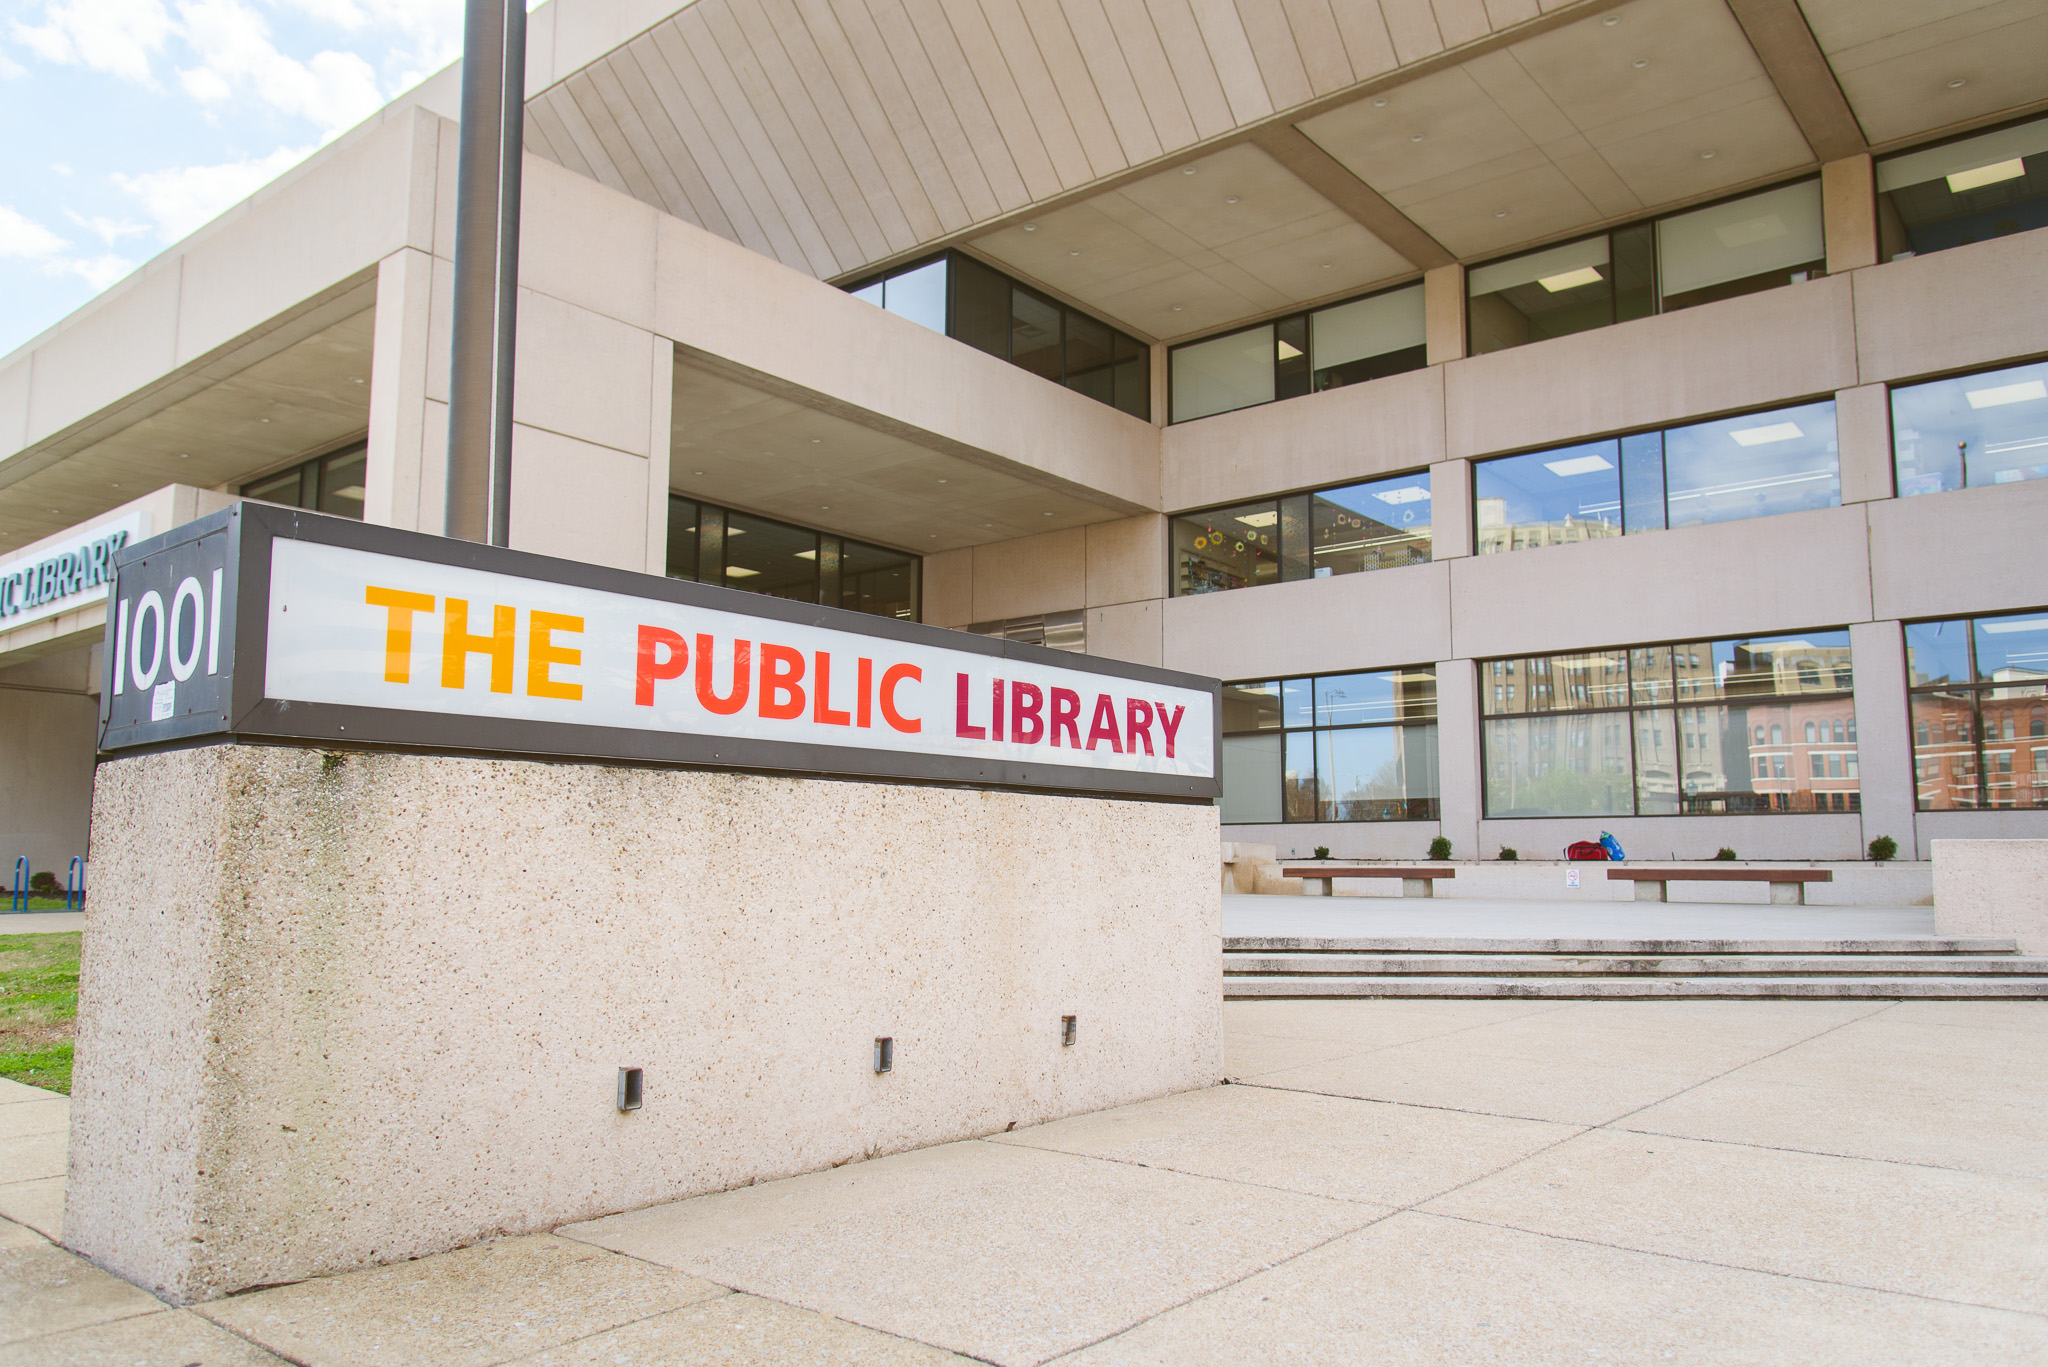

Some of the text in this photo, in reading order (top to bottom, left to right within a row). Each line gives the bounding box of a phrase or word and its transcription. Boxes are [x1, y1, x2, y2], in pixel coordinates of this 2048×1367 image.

[114, 567, 223, 696] 1001
[366, 585, 1187, 759] THE PUBLIC LIBRARY
